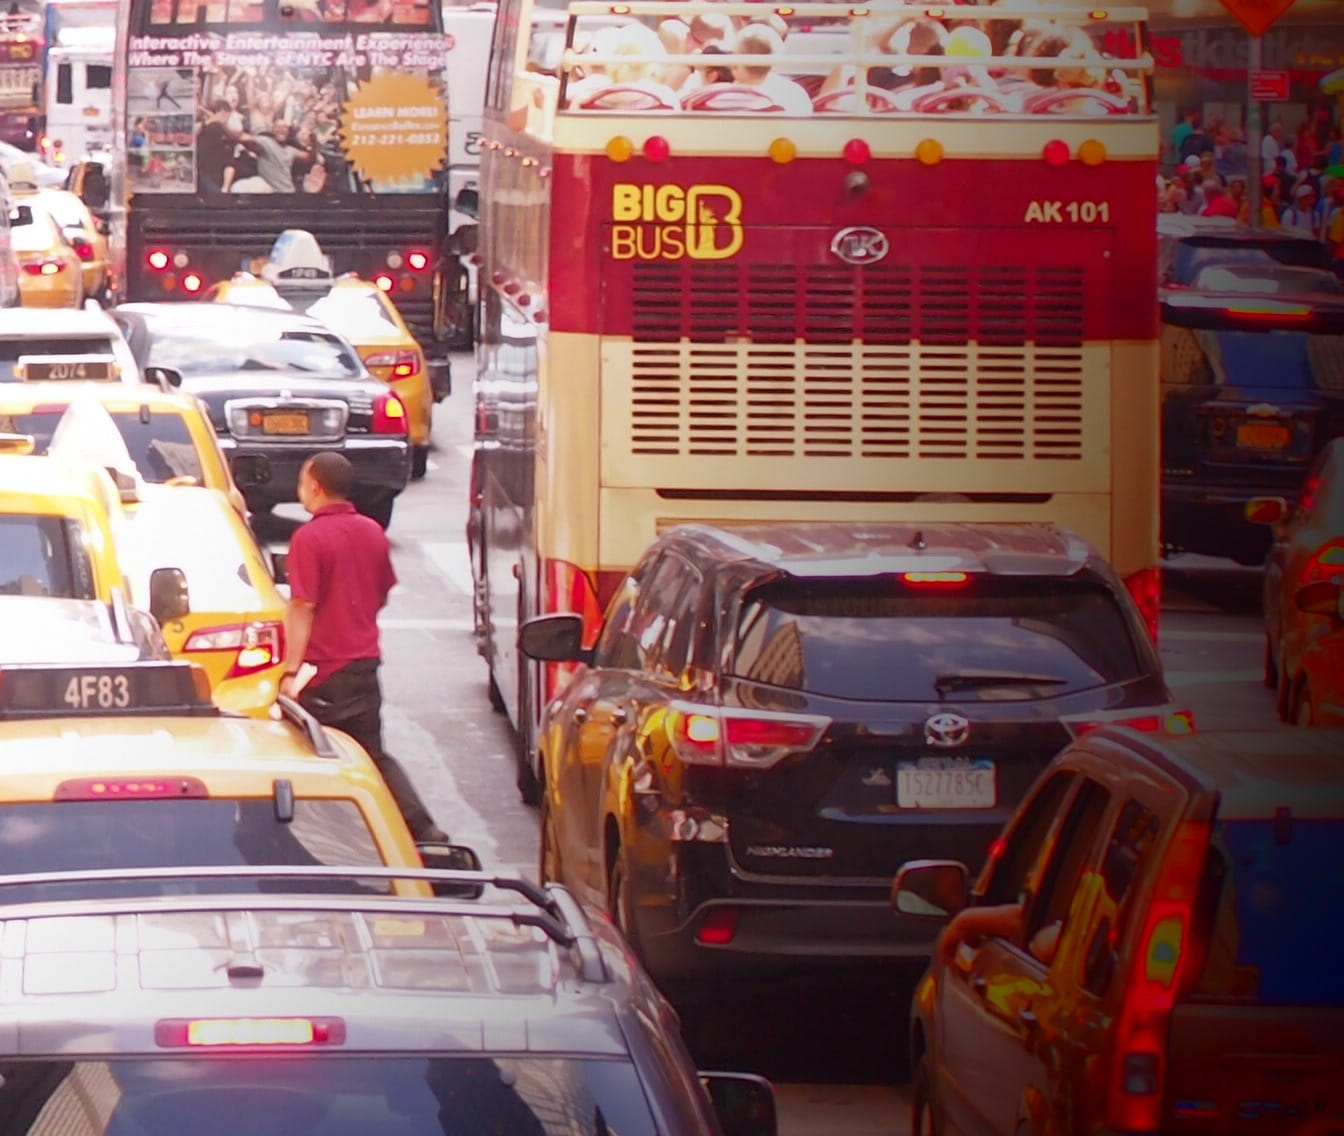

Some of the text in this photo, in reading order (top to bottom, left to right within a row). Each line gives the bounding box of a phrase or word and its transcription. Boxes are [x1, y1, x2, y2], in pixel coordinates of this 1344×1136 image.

[226, 34, 353, 52] Entertainment
[181, 52, 213, 67] The
[215, 52, 270, 67] Streets
[296, 52, 332, 68] NYC
[336, 53, 366, 68] Are
[370, 53, 400, 68] The
[612, 183, 686, 222] BIG
[1024, 199, 1110, 224] AK 101
[611, 224, 685, 260] BUS
[48, 363, 87, 381] 2074
[63, 672, 131, 709] 4F83
